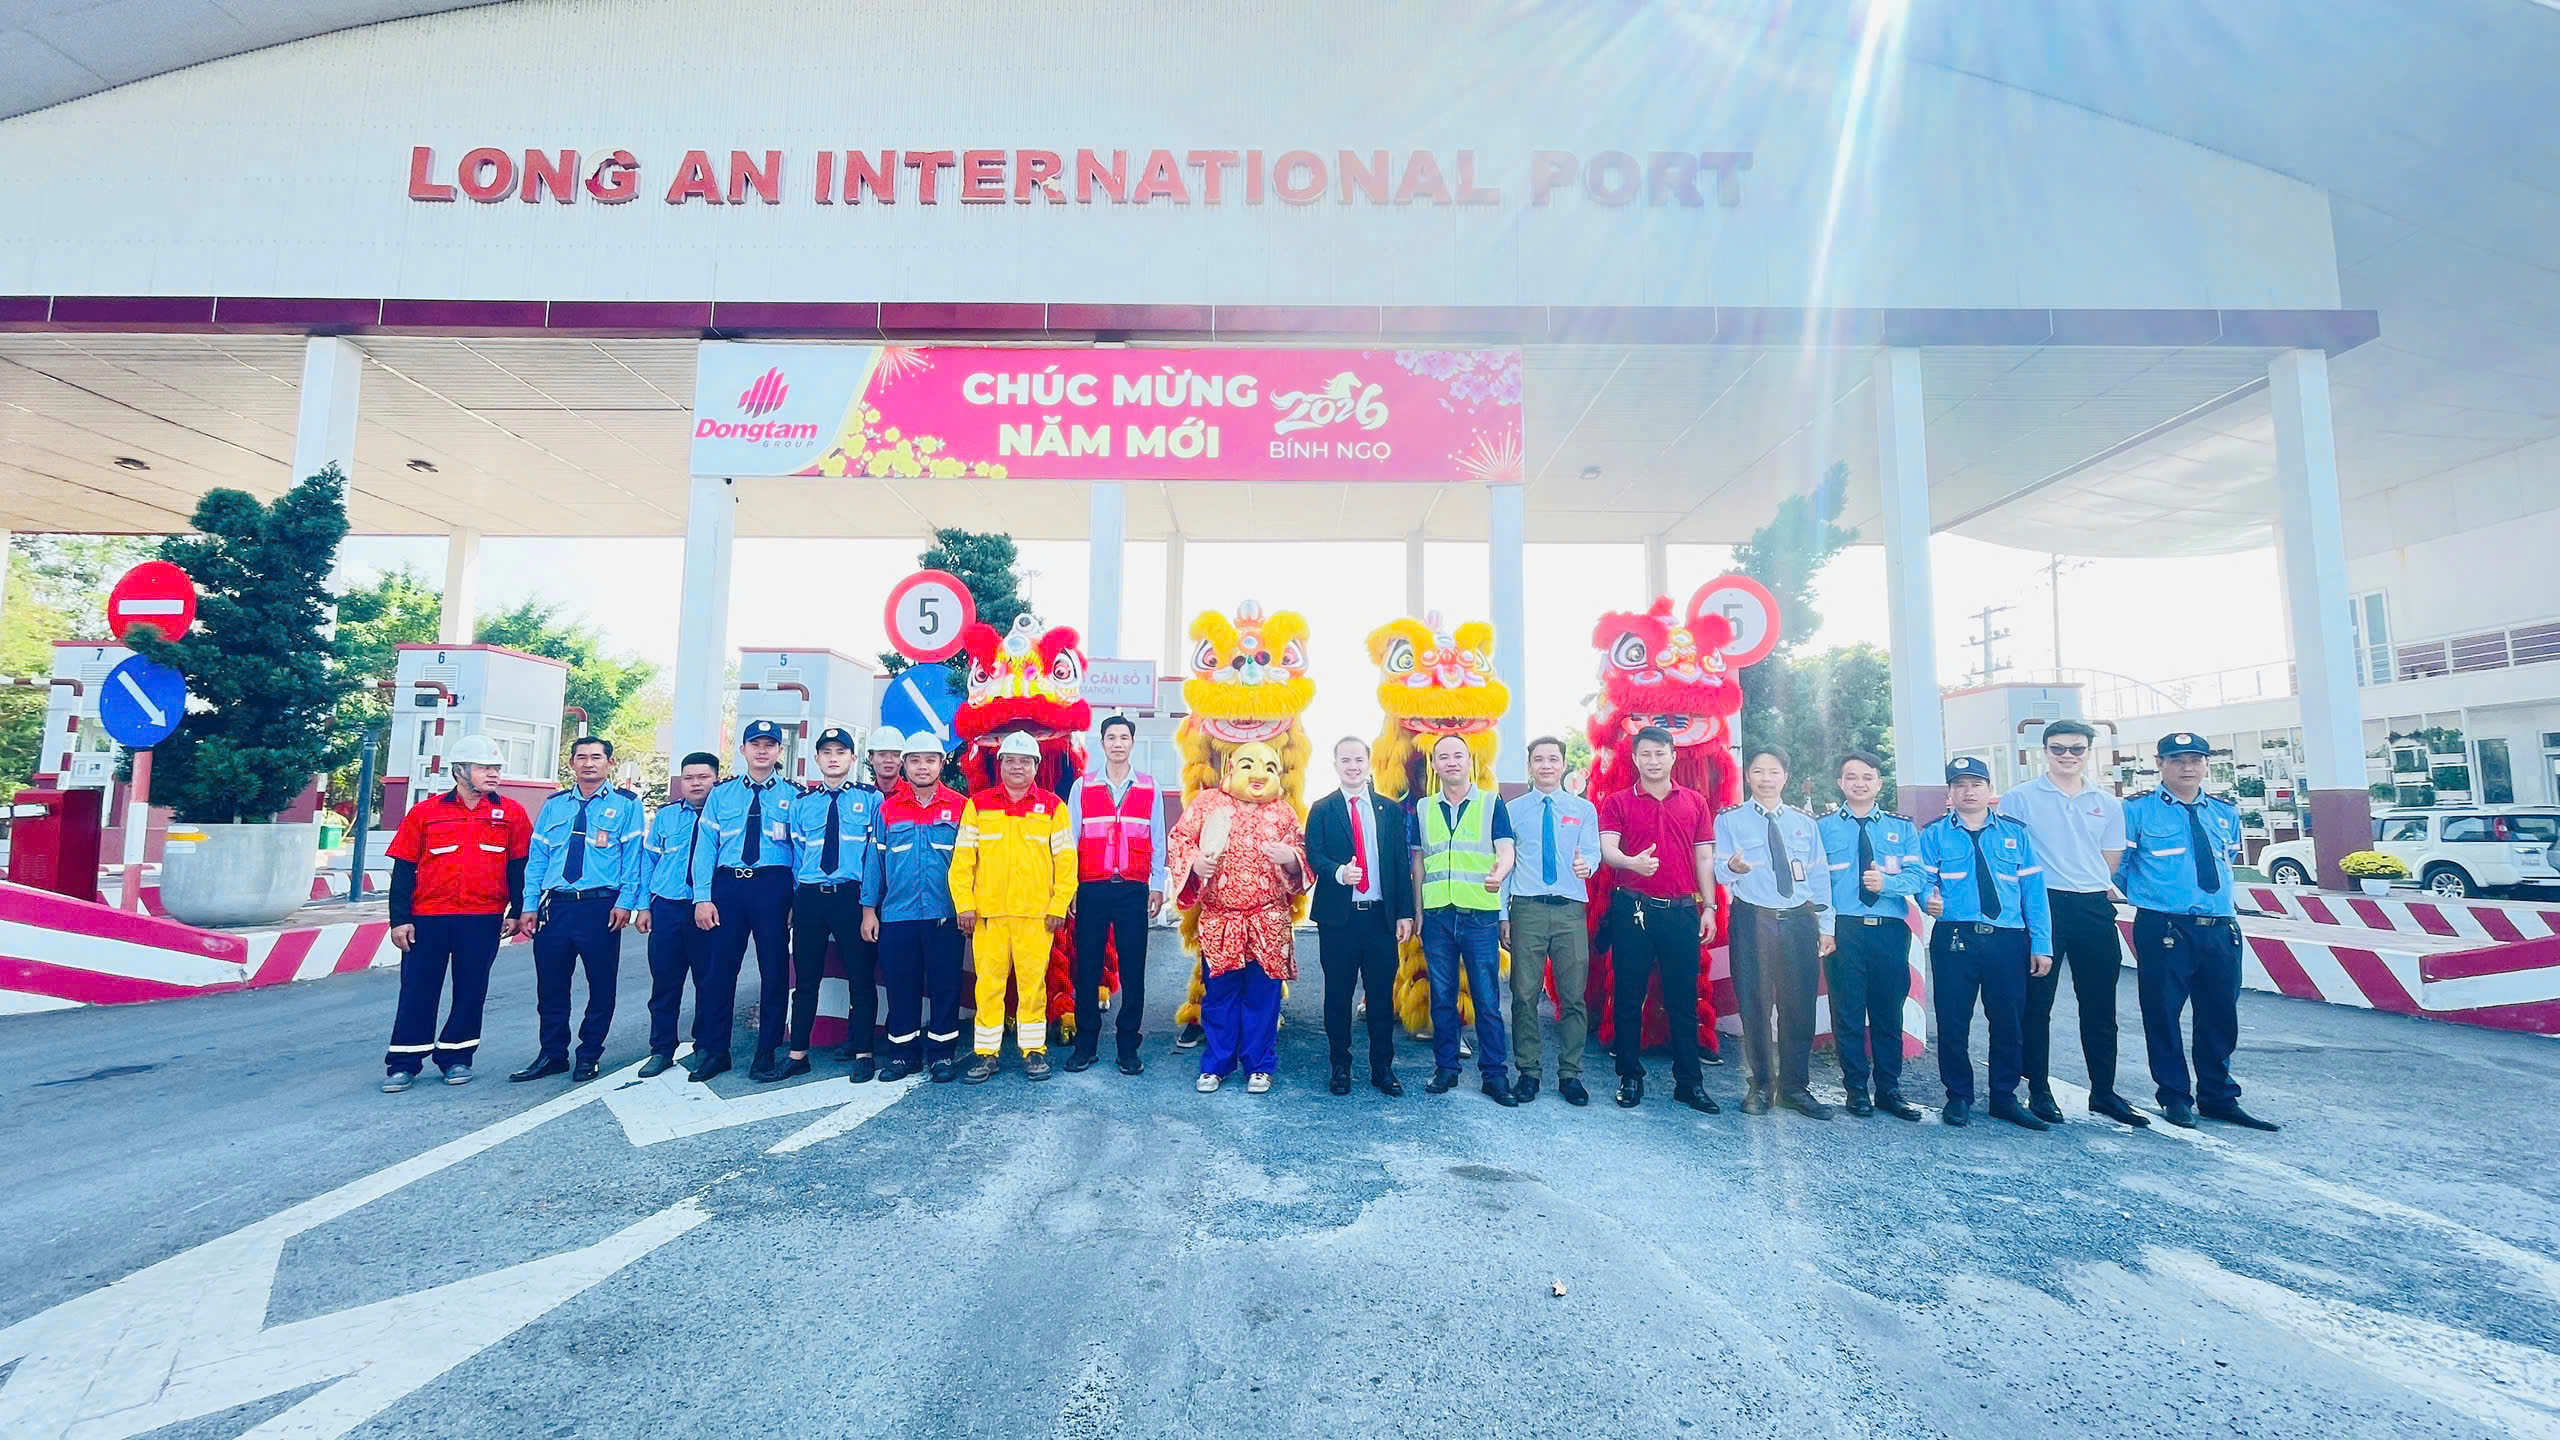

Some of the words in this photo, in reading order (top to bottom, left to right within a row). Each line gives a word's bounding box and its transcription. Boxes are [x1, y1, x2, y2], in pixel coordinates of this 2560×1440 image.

[408, 147, 639, 203] LONG
[664, 149, 782, 204] AN
[815, 149, 1500, 206] INTERNATIONAL
[1532, 150, 1754, 207] PORT
[962, 365, 1099, 406] CHÚC
[1112, 366, 1258, 407] MỪNG
[1269, 383, 1389, 436] 2026
[695, 418, 818, 444] Dongtam
[762, 440, 814, 448] GROUP
[999, 415, 1110, 457] NĂM
[1126, 417, 1219, 458] MỚI
[1269, 437, 1329, 459] BÍNH
[1337, 441, 1391, 463] NGỌ
[919, 597, 940, 636] 5
[96, 648, 104, 661] 7
[438, 651, 446, 664] 6
[780, 653, 788, 667] 5
